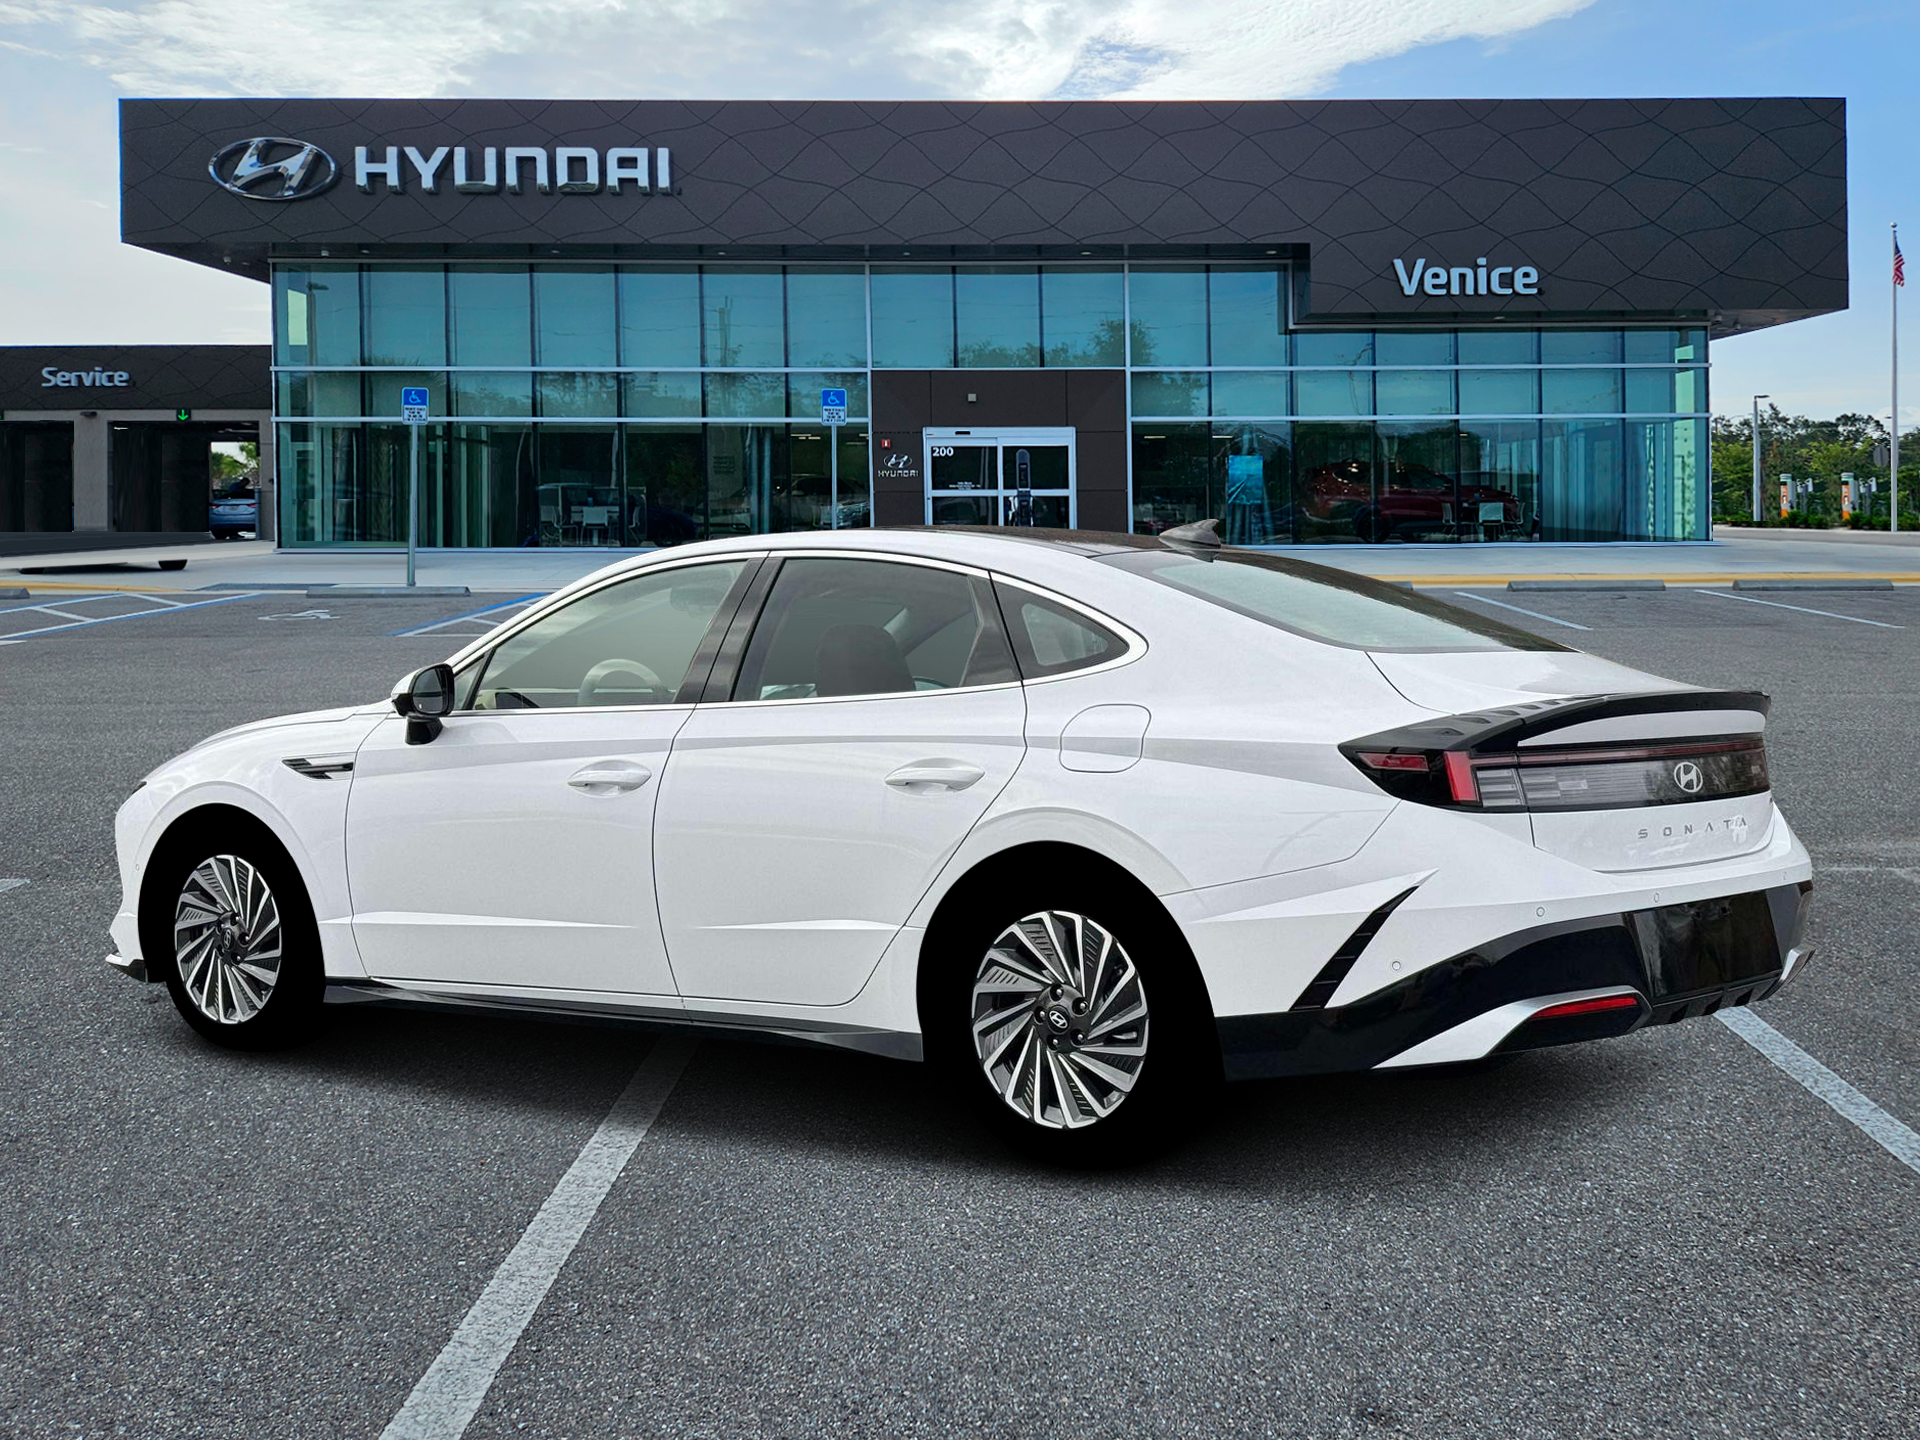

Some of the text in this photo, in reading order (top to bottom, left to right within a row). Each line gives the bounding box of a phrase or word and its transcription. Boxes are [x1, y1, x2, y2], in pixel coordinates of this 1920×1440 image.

[355, 146, 670, 194] HYUNDAI
[1393, 257, 1539, 296] Venice
[41, 366, 130, 387] Service
[932, 446, 954, 457] 200
[878, 469, 918, 478] HYUNDAI
[1637, 817, 1748, 840] SONATA
